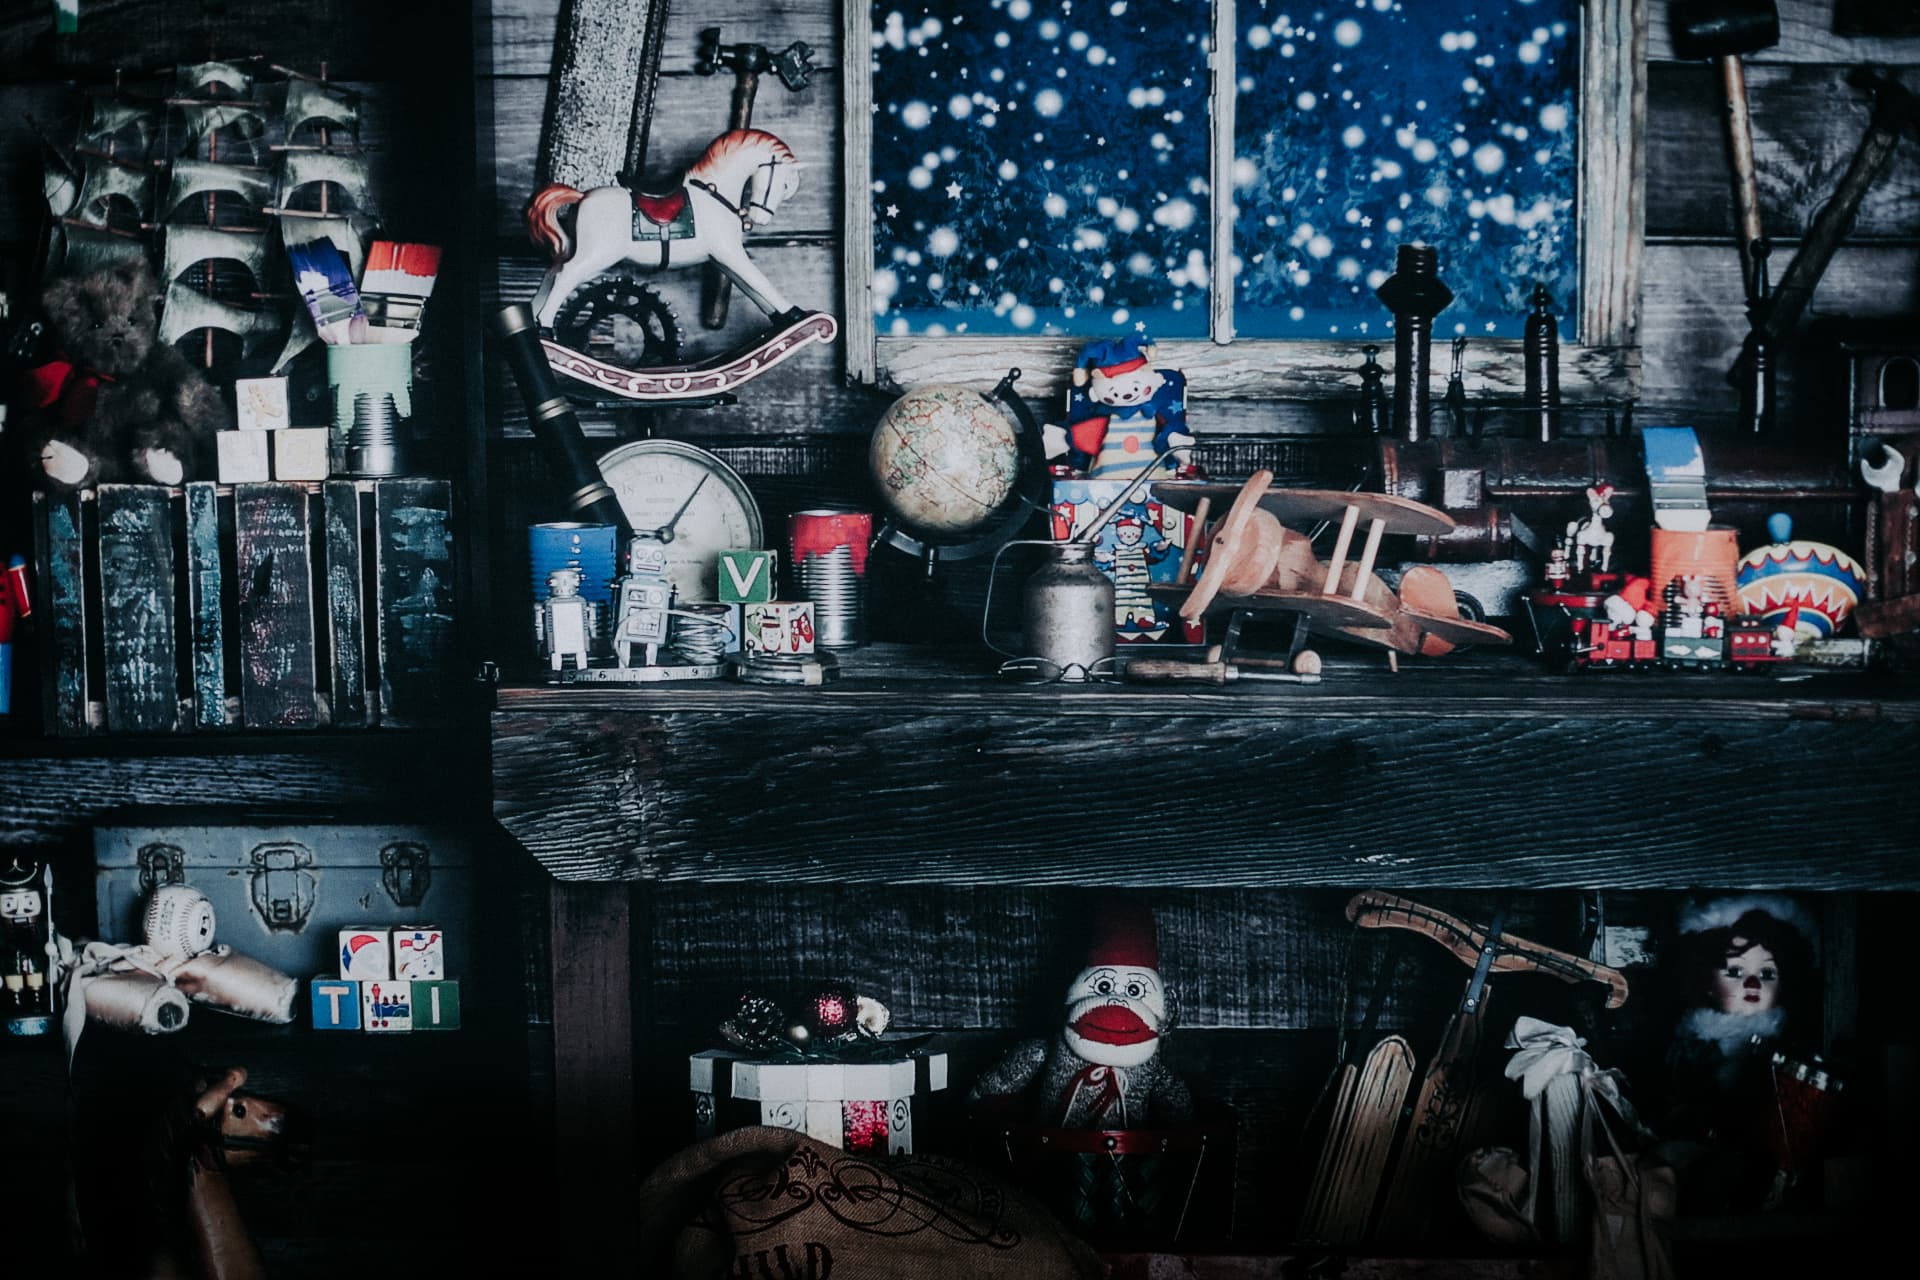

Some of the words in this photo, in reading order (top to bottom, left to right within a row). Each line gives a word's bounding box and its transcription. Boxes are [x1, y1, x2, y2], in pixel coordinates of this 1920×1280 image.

[723, 556, 765, 598] V
[599, 669, 606, 679] 6
[319, 987, 349, 1024] T
